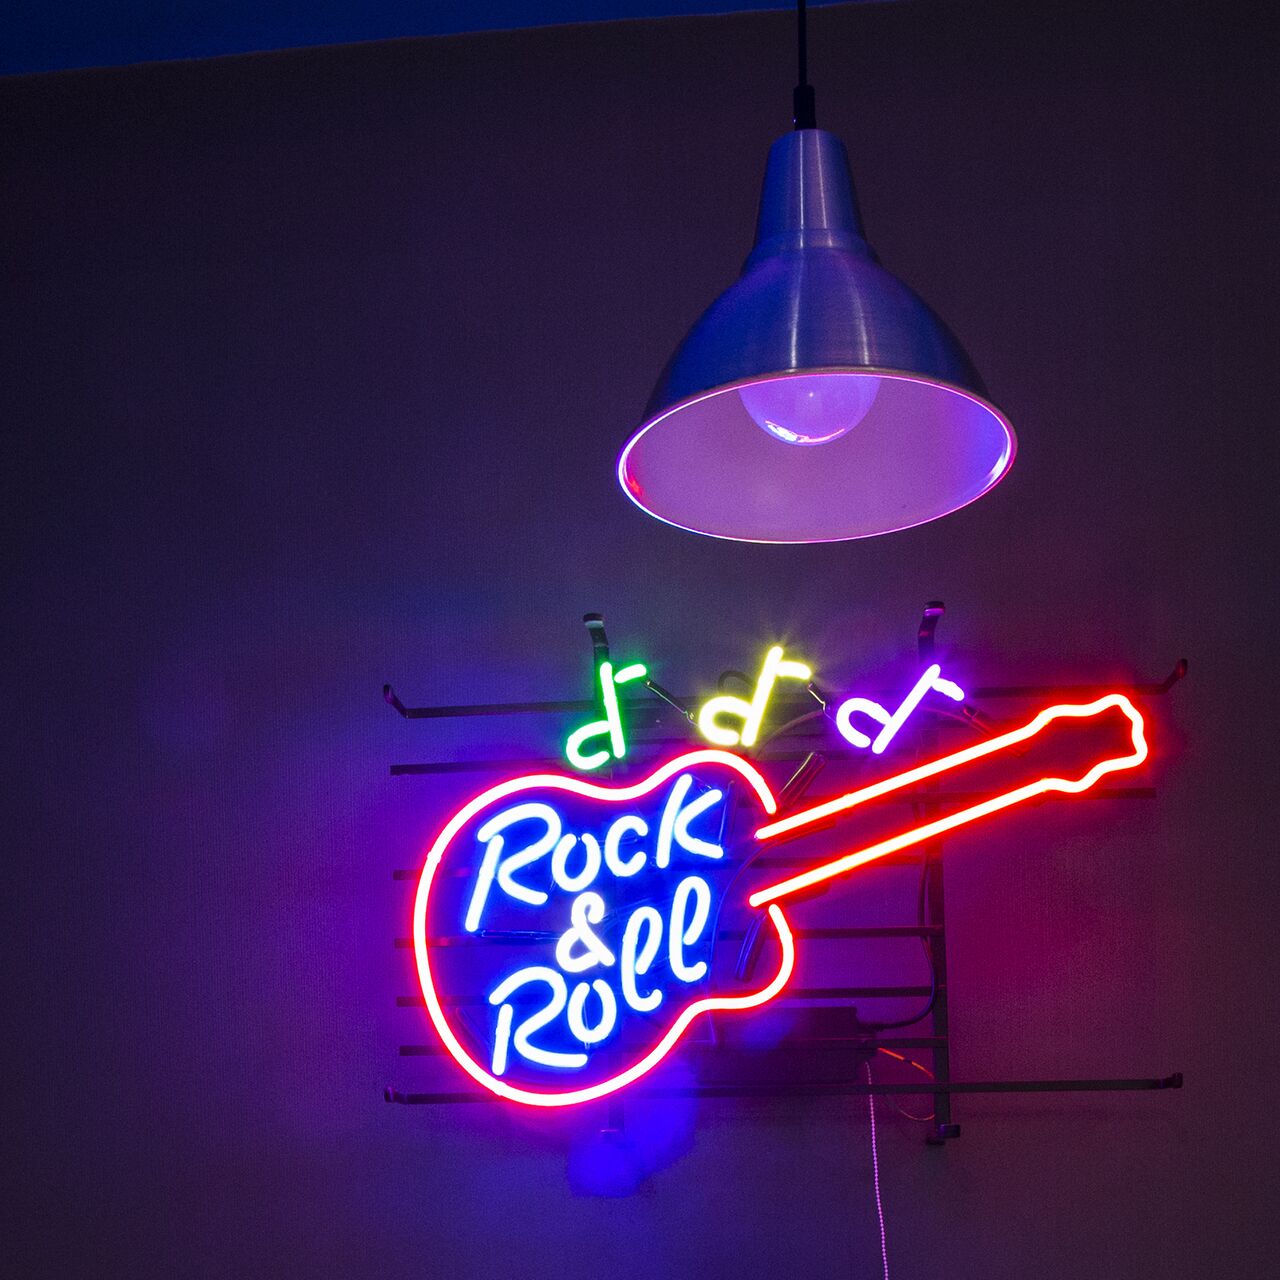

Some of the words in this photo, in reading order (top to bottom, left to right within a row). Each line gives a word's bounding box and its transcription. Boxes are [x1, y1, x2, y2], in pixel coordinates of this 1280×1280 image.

[465, 773, 724, 932] Rock
[489, 875, 711, 1076] Roll
[555, 892, 616, 973] &
